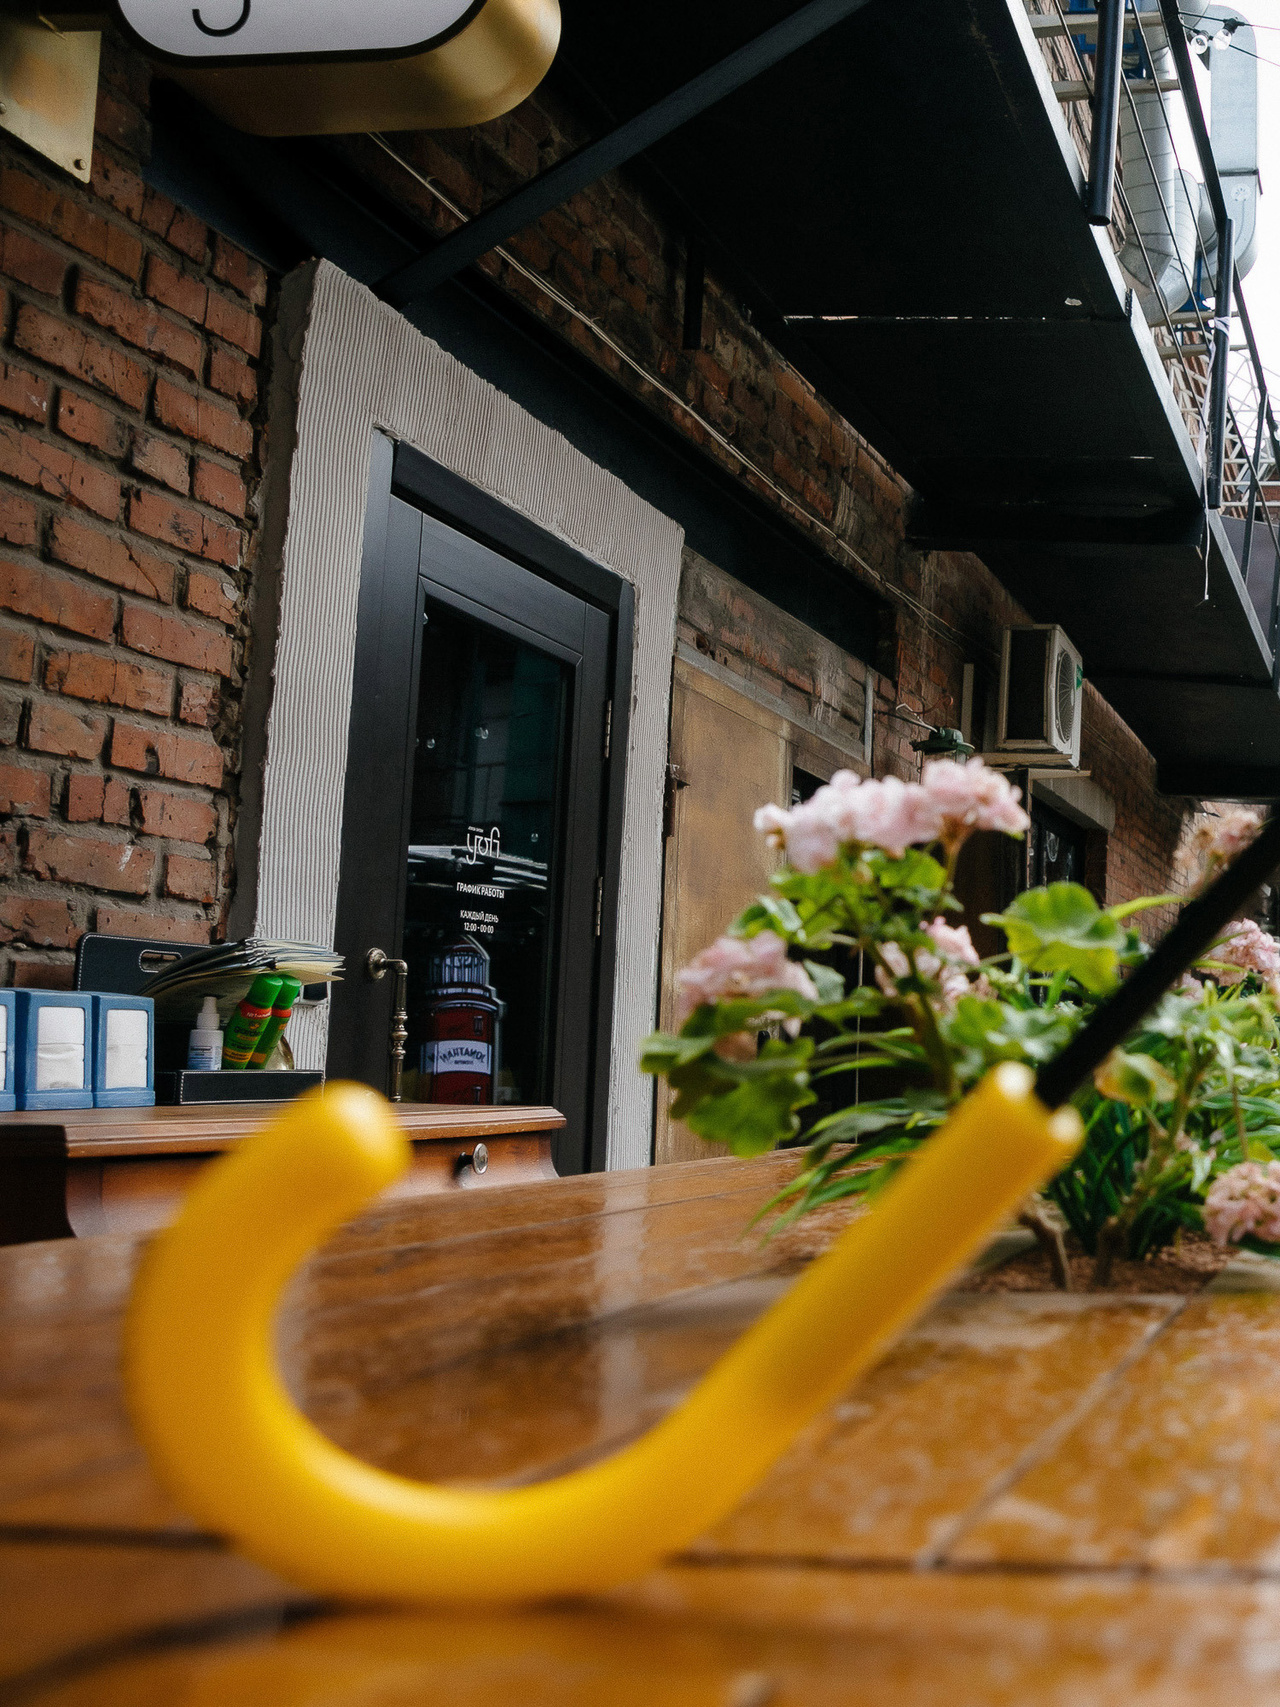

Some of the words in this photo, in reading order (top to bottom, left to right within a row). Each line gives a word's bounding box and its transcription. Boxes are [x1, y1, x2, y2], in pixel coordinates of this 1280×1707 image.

[456, 881, 481, 896] ГРАФИК
[480, 886, 505, 899] РАБОТЫ
[459, 909, 485, 921] КАЖДЫЙ
[484, 913, 499, 924] ДЕНЬ
[463, 921, 477, 932] 12:00
[479, 923, 494, 934] 00:00
